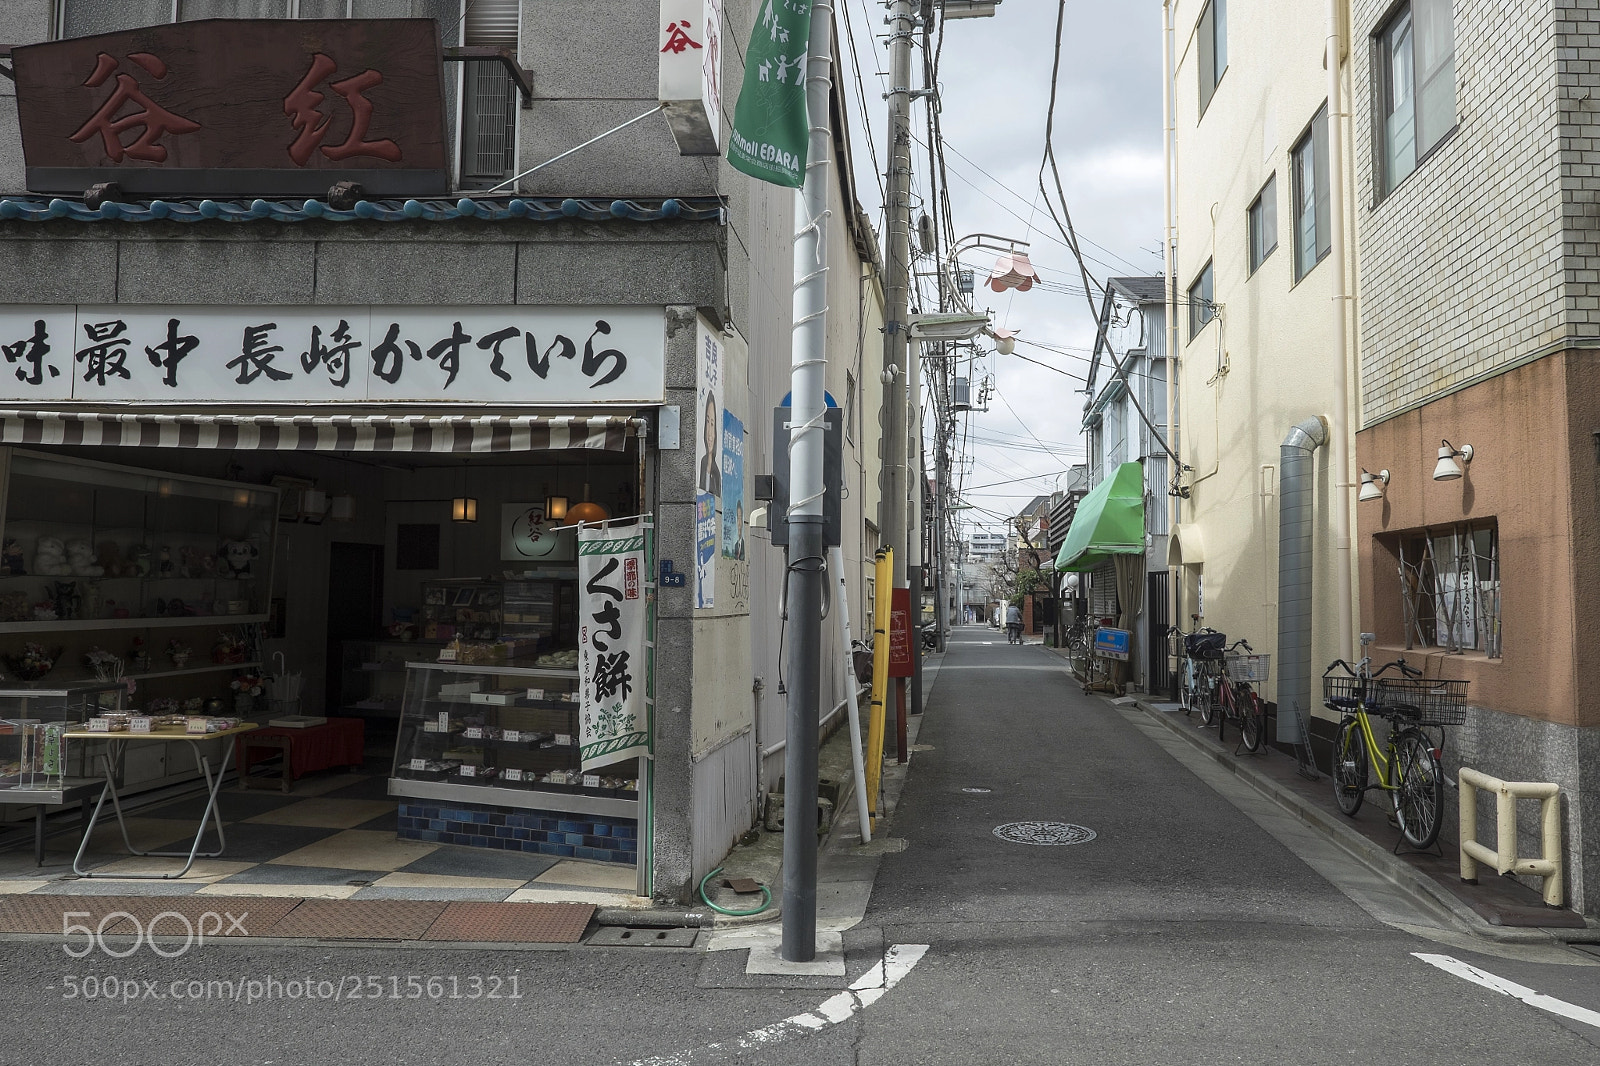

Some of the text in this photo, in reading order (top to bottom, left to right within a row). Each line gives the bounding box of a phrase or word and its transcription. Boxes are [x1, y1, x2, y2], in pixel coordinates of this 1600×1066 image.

[660, 20, 703, 54] 谷
[760, 143, 800, 172] EBARA
[225, 318, 629, 390] 長崎かすていら
[528, 511, 543, 543] 紅谷
[664, 576, 680, 584] 9-8
[586, 557, 632, 703] くさ餅
